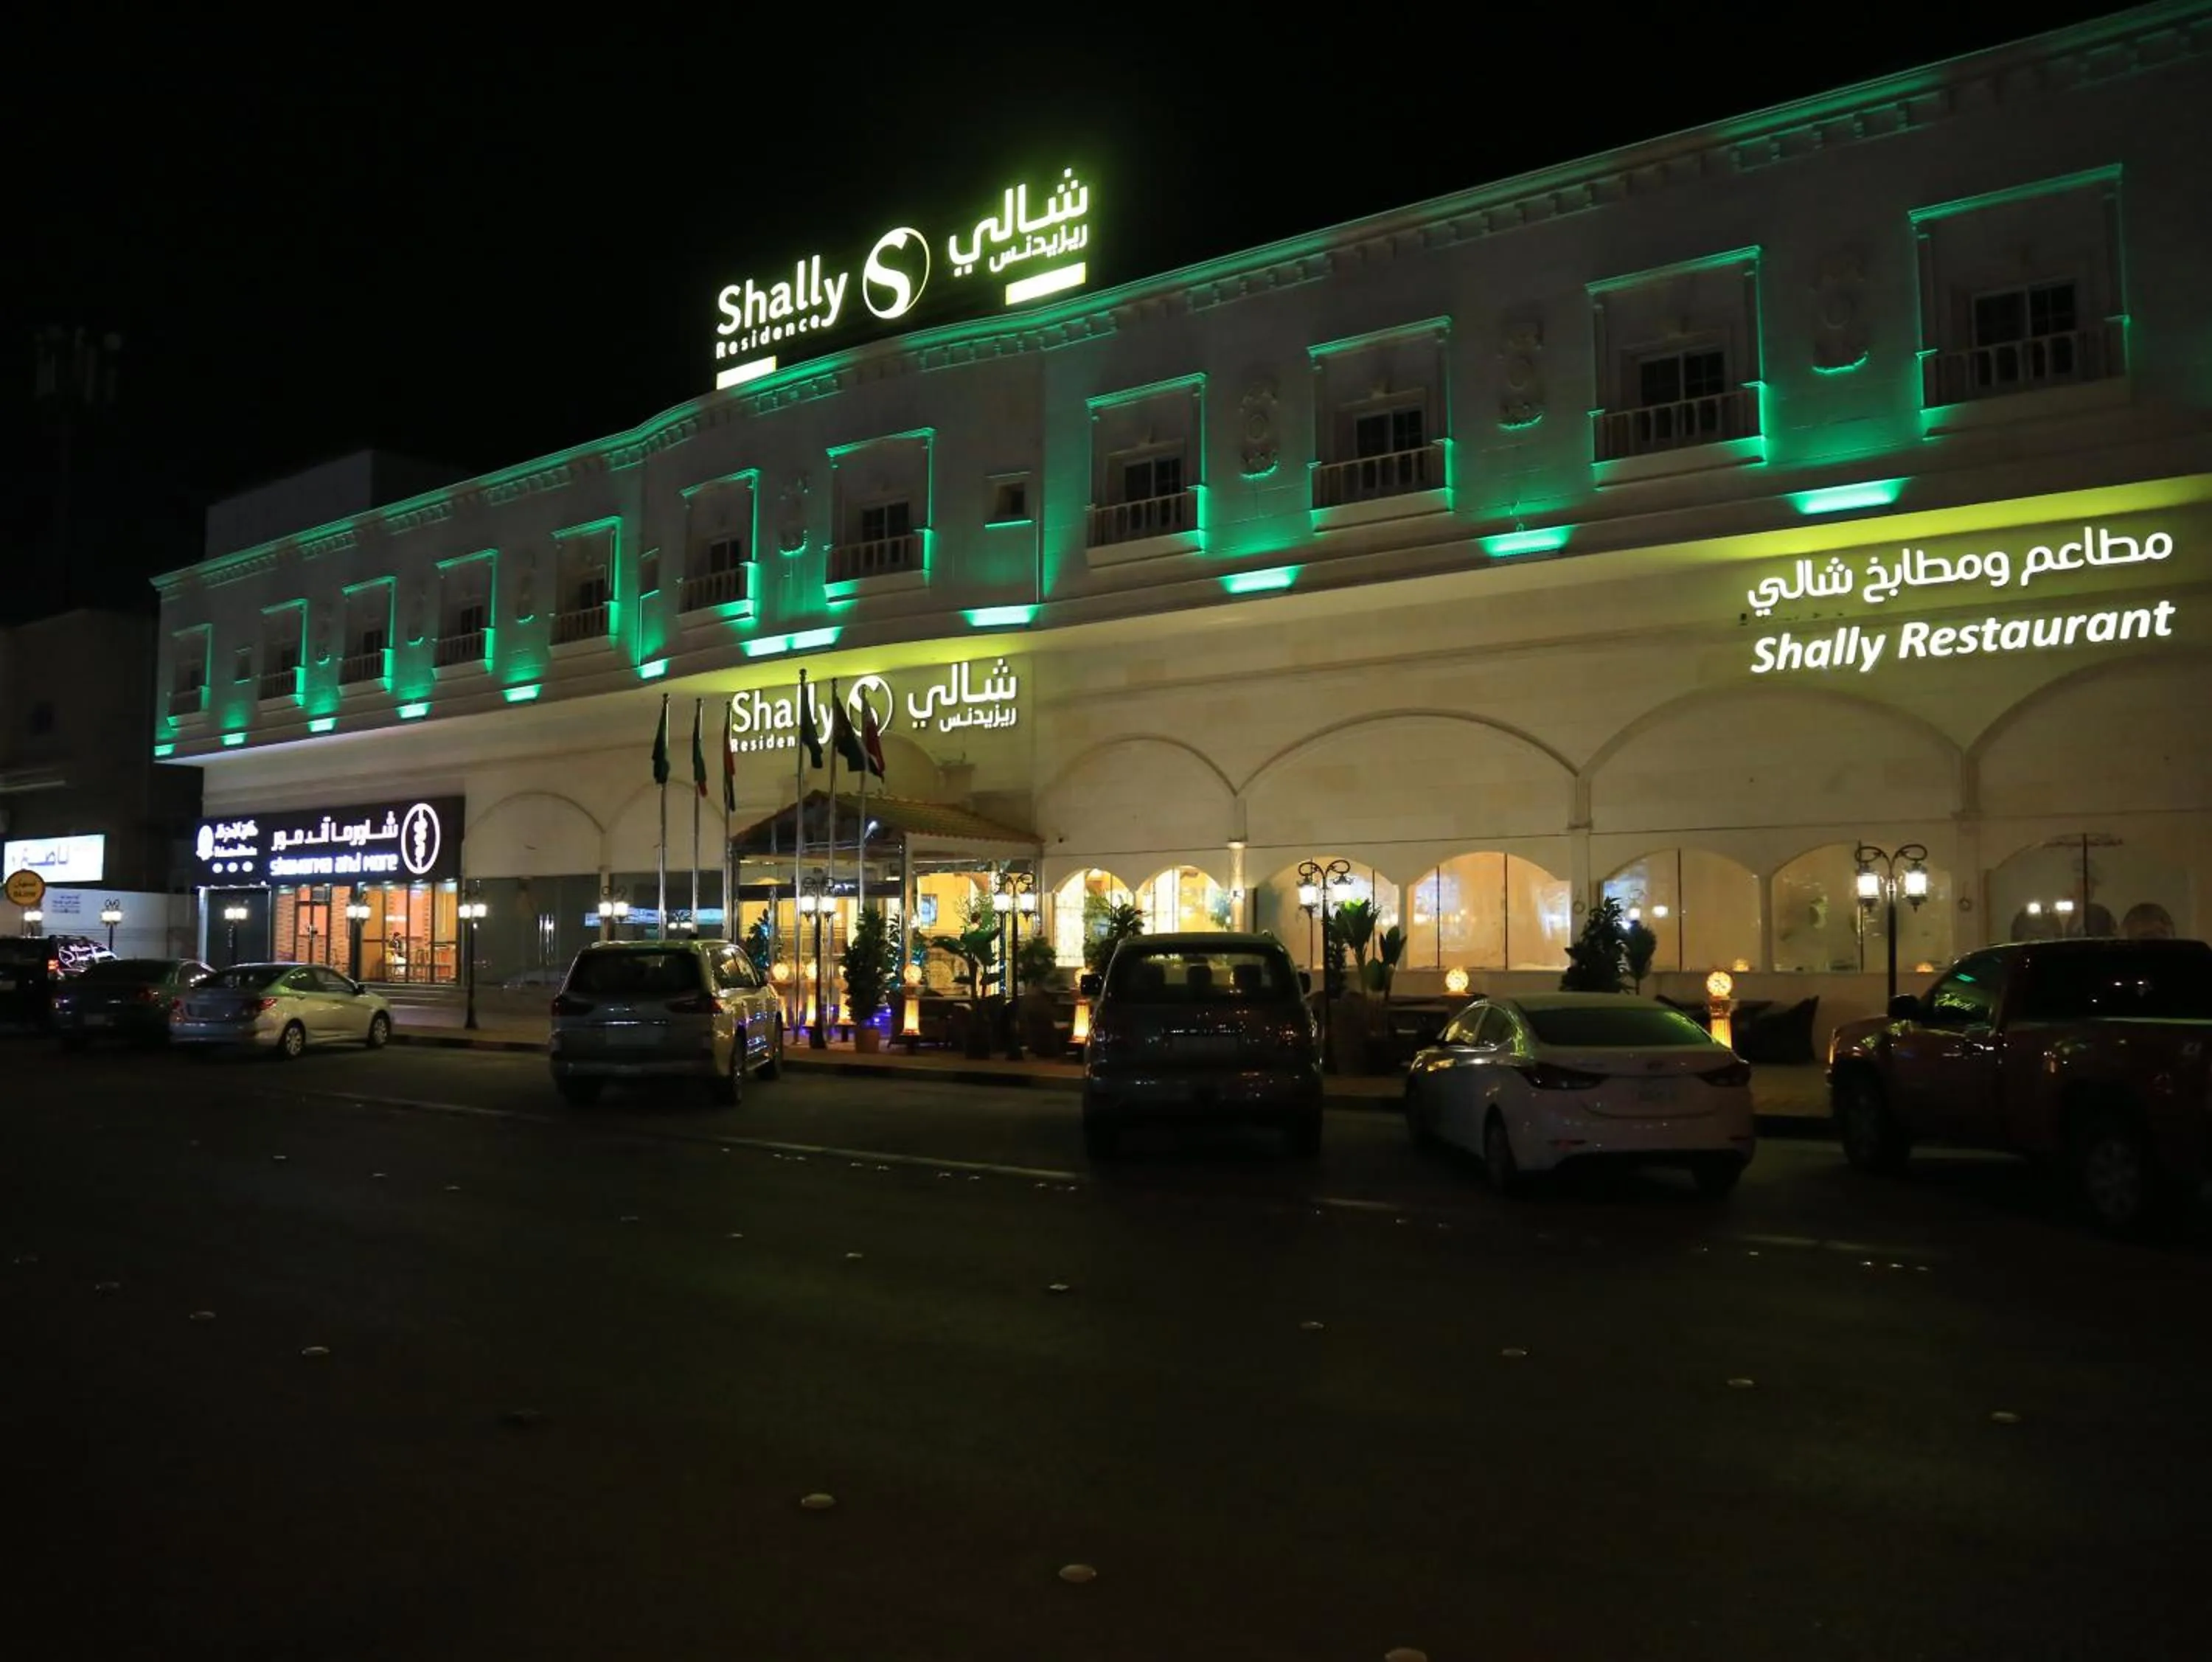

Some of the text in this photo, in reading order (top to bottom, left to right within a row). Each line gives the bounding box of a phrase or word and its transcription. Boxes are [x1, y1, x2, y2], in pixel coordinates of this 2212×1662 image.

[948, 168, 1088, 277] شالي
[989, 224, 1088, 273] ريزيدنس
[717, 254, 849, 335] Shally
[716, 314, 820, 359] Residence
[1747, 526, 2173, 617] مطاعم ومطابخ شالي
[1750, 600, 2176, 673] Shally Restaurant
[908, 658, 1017, 729] شالي
[939, 707, 1017, 733] ريزيدنس
